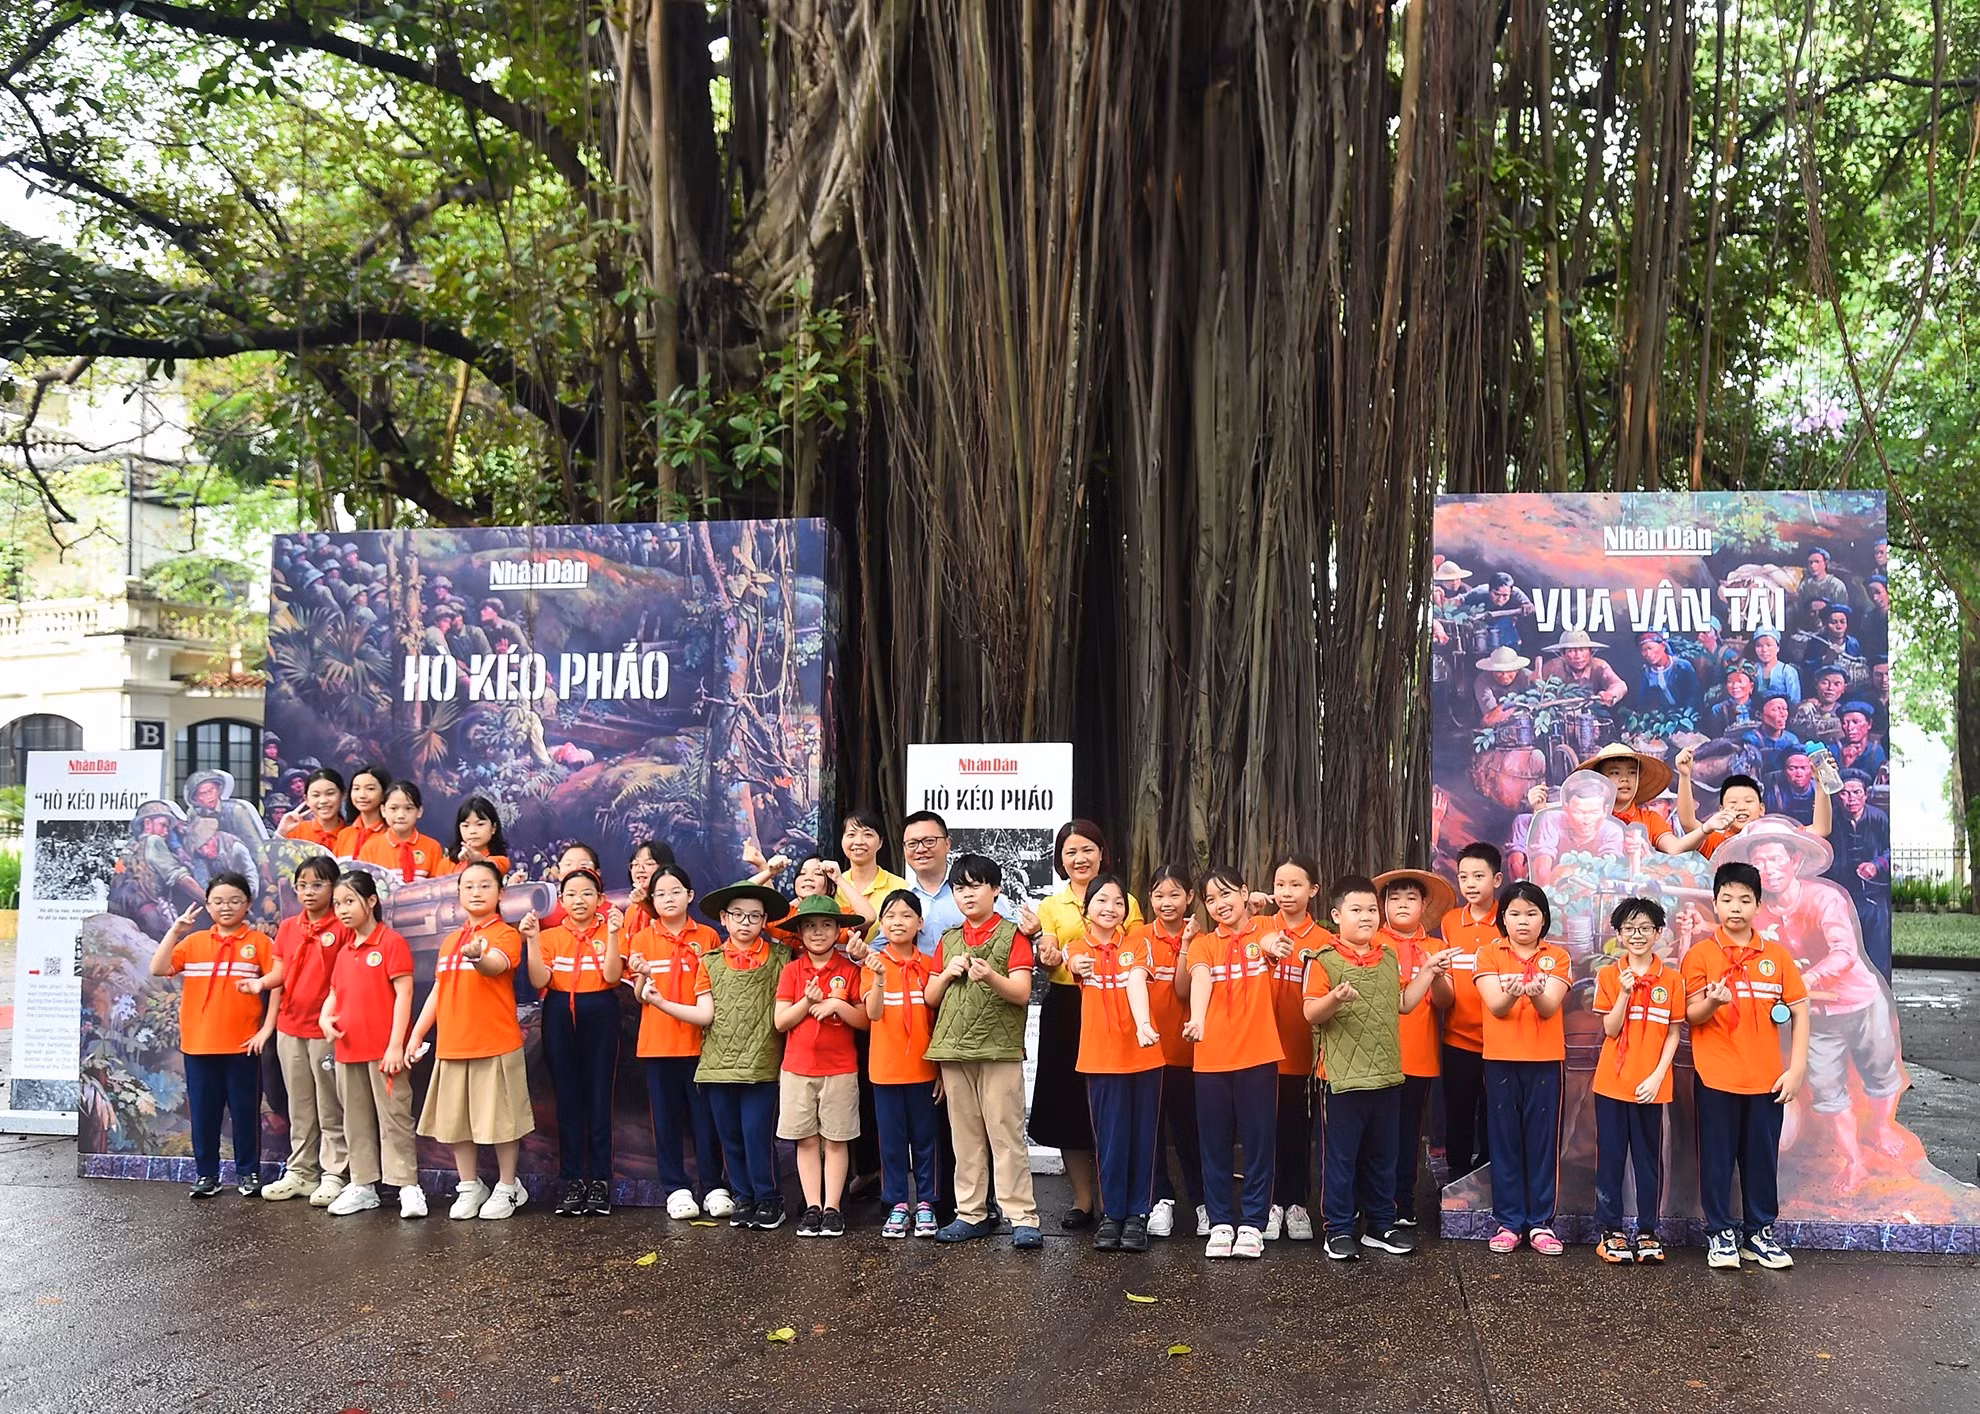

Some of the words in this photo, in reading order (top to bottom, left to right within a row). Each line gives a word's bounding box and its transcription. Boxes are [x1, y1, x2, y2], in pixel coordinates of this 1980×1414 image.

[1603, 526, 1665, 550] Nhân
[1667, 526, 1712, 550] Dân
[489, 560, 545, 585] Nhân
[546, 559, 588, 584] Dân
[1532, 588, 1615, 632] VUA
[403, 645, 457, 702] HÒ
[469, 644, 546, 701] KÉO
[559, 641, 670, 700] PHÁO
[141, 724, 160, 745] B
[69, 759, 95, 772] Nhân
[96, 759, 117, 772] Dân
[958, 758, 992, 772] Nhân
[993, 758, 1018, 772] Dân
[67, 788, 95, 810] KÉO
[924, 784, 950, 811] HÒ
[956, 784, 993, 811] KÉO
[1000, 784, 1053, 811] PHÁO
